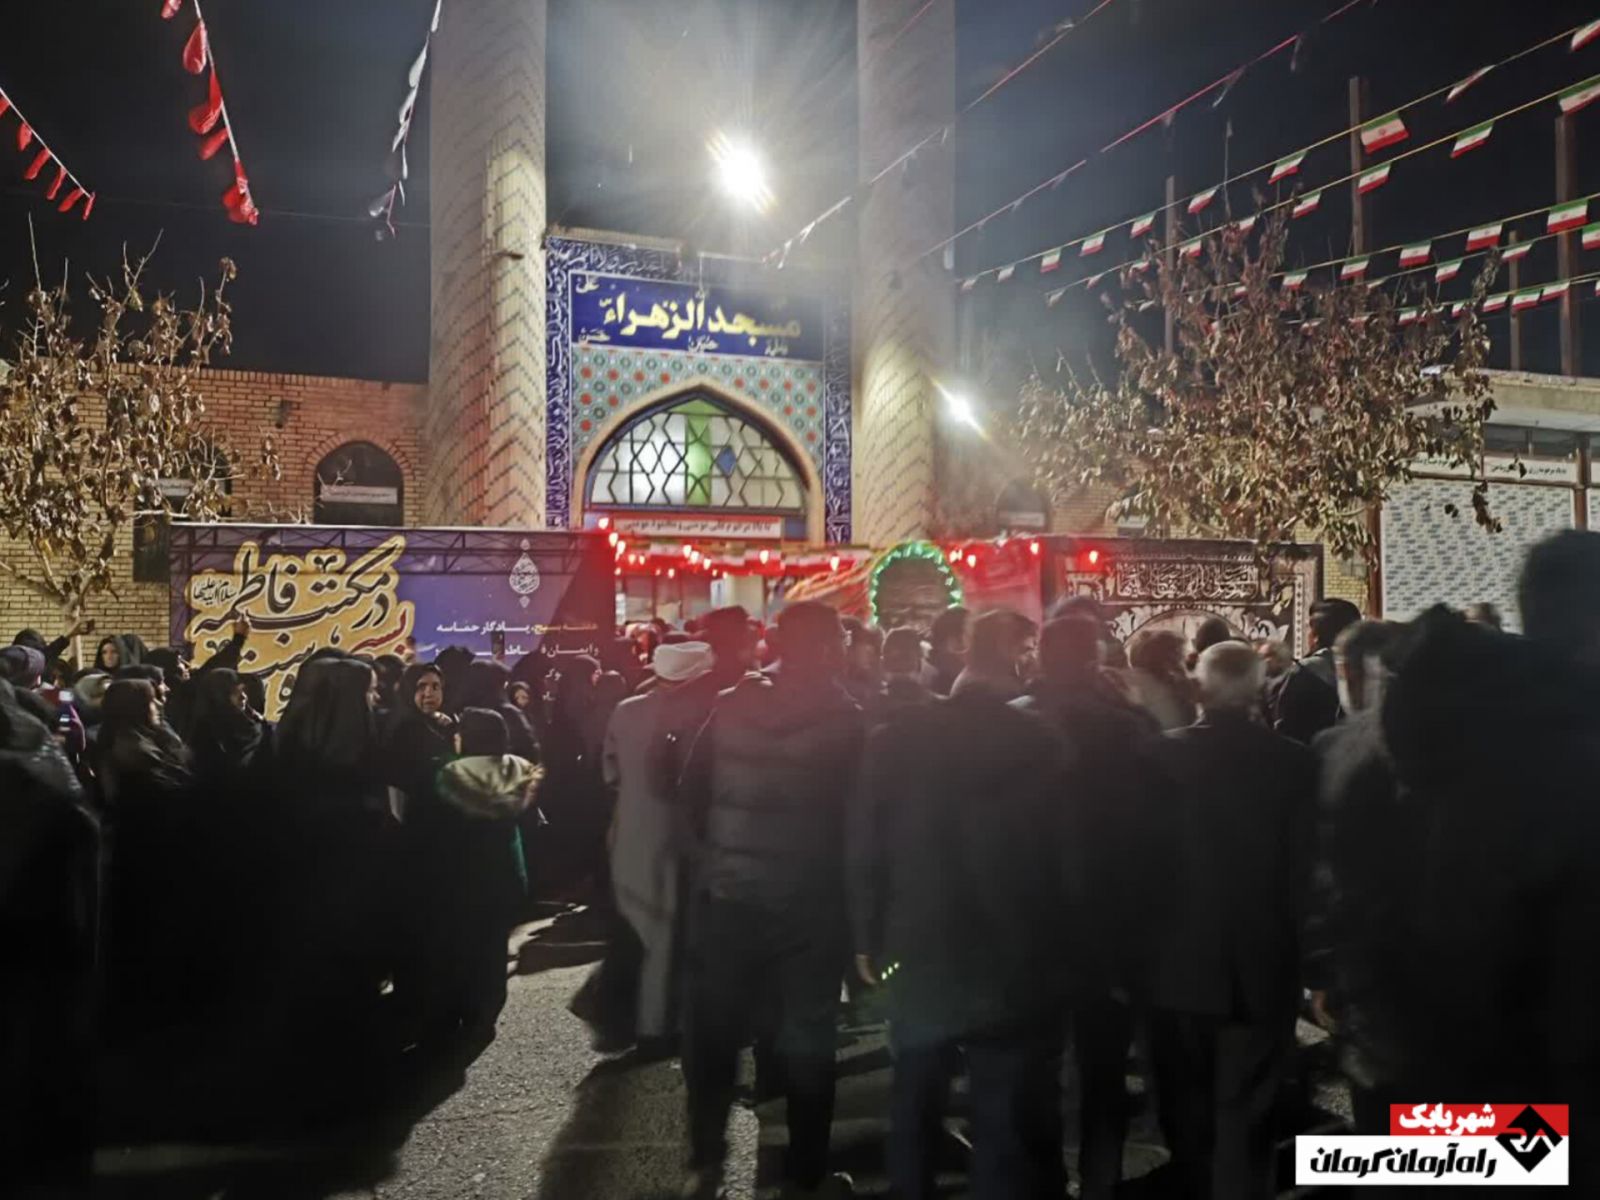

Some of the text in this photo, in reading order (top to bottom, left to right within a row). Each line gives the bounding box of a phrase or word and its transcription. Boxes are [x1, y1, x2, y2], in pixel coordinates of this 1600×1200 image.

[707, 306, 801, 345] مسجد
[246, 542, 402, 645] مکتب
[350, 590, 390, 631] در
[435, 620, 479, 633] حماسه
[480, 619, 530, 636] یادگار
